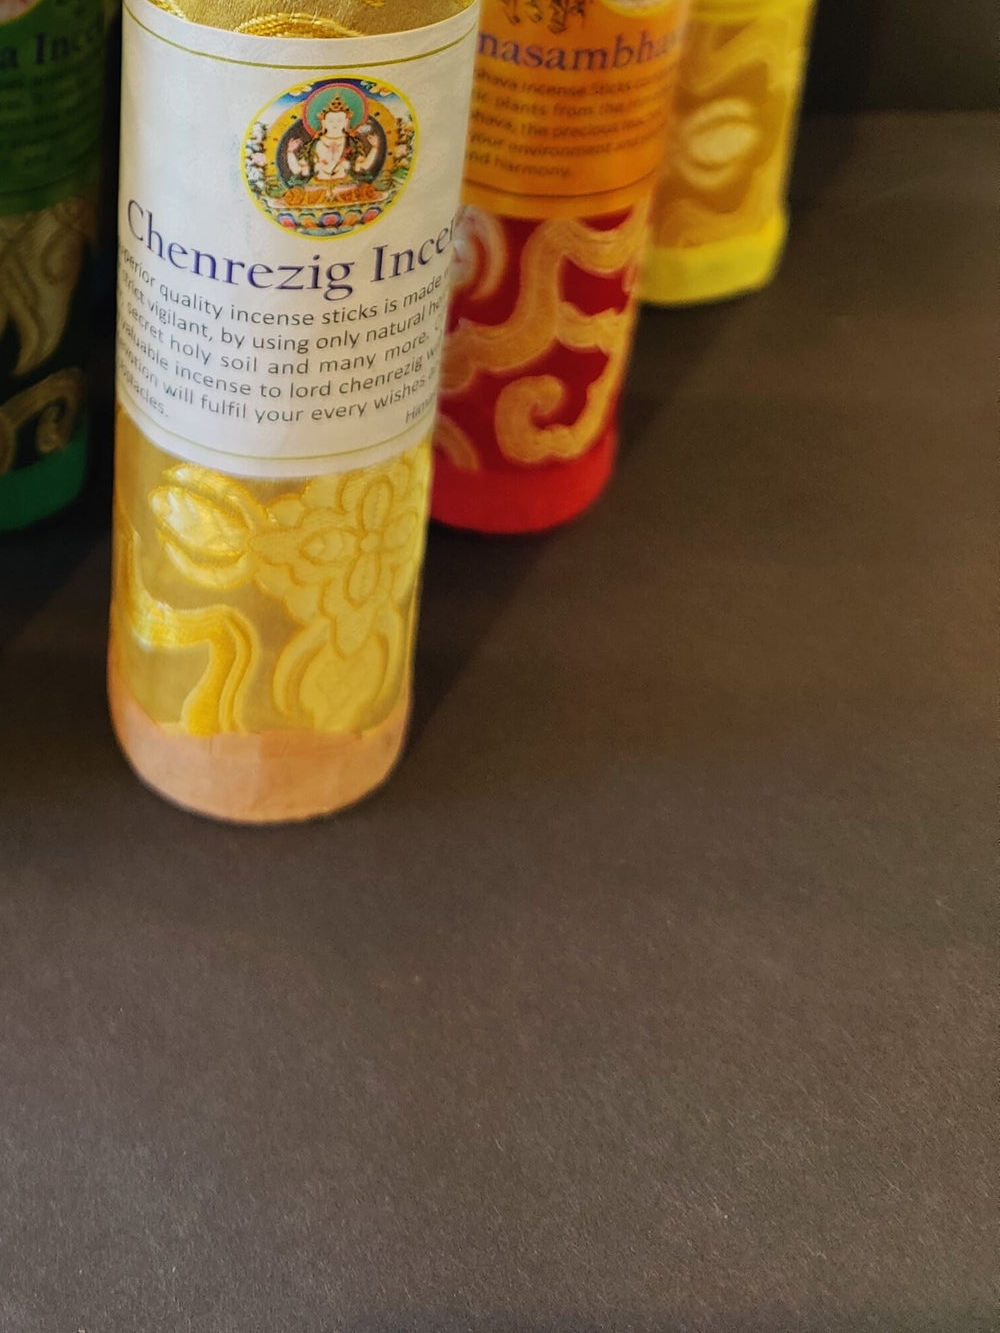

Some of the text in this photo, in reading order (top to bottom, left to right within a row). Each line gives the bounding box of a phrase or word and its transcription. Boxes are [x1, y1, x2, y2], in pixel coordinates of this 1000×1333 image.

[127, 198, 355, 301] Chenrezig
[147, 298, 214, 343] vigilant,
[220, 326, 246, 349] by
[252, 335, 309, 355] using
[316, 329, 361, 349] only
[366, 304, 426, 343] natural
[160, 283, 224, 320] quality
[230, 304, 314, 326] incense
[321, 303, 378, 325] sticks
[383, 298, 398, 314] is
[402, 274, 441, 308] made
[127, 301, 164, 344] secret
[170, 334, 212, 365] holy
[220, 354, 257, 373] soil
[268, 358, 309, 375] and
[319, 353, 377, 373] many
[384, 331, 430, 362] more.
[162, 380, 194, 405] will
[200, 394, 247, 419] fulfil
[254, 408, 304, 424] your
[311, 402, 368, 421] every
[373, 375, 426, 410] wishes
[175, 360, 251, 395] incense
[259, 383, 281, 398] to
[290, 380, 331, 398] lord
[338, 354, 423, 394] chenrezig
